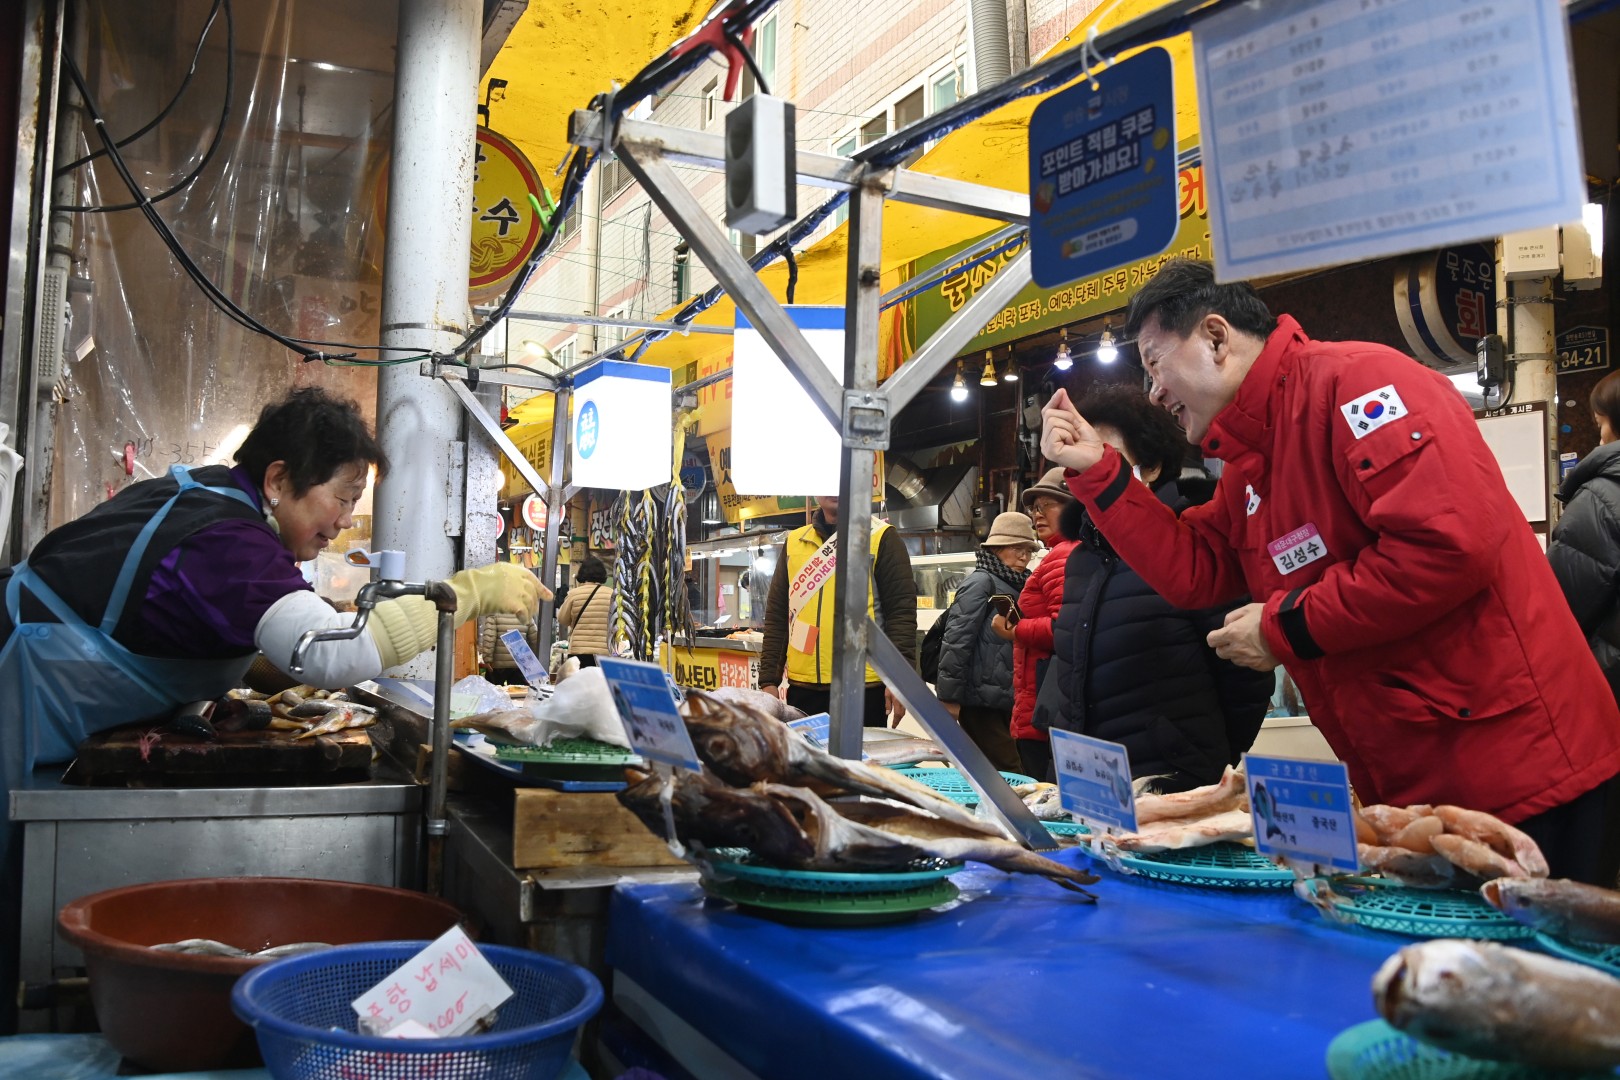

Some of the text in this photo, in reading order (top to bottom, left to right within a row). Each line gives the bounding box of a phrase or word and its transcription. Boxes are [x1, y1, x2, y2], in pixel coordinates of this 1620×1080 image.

[1041, 108, 1154, 176] 포인트 적립 쿠폰
[1057, 142, 1139, 195] 받아가세요!
[1019, 301, 1040, 321] 포장
[1103, 270, 1127, 294] 주문
[1510, 404, 1533, 414] 게시판
[1279, 542, 1320, 570] 김성수
